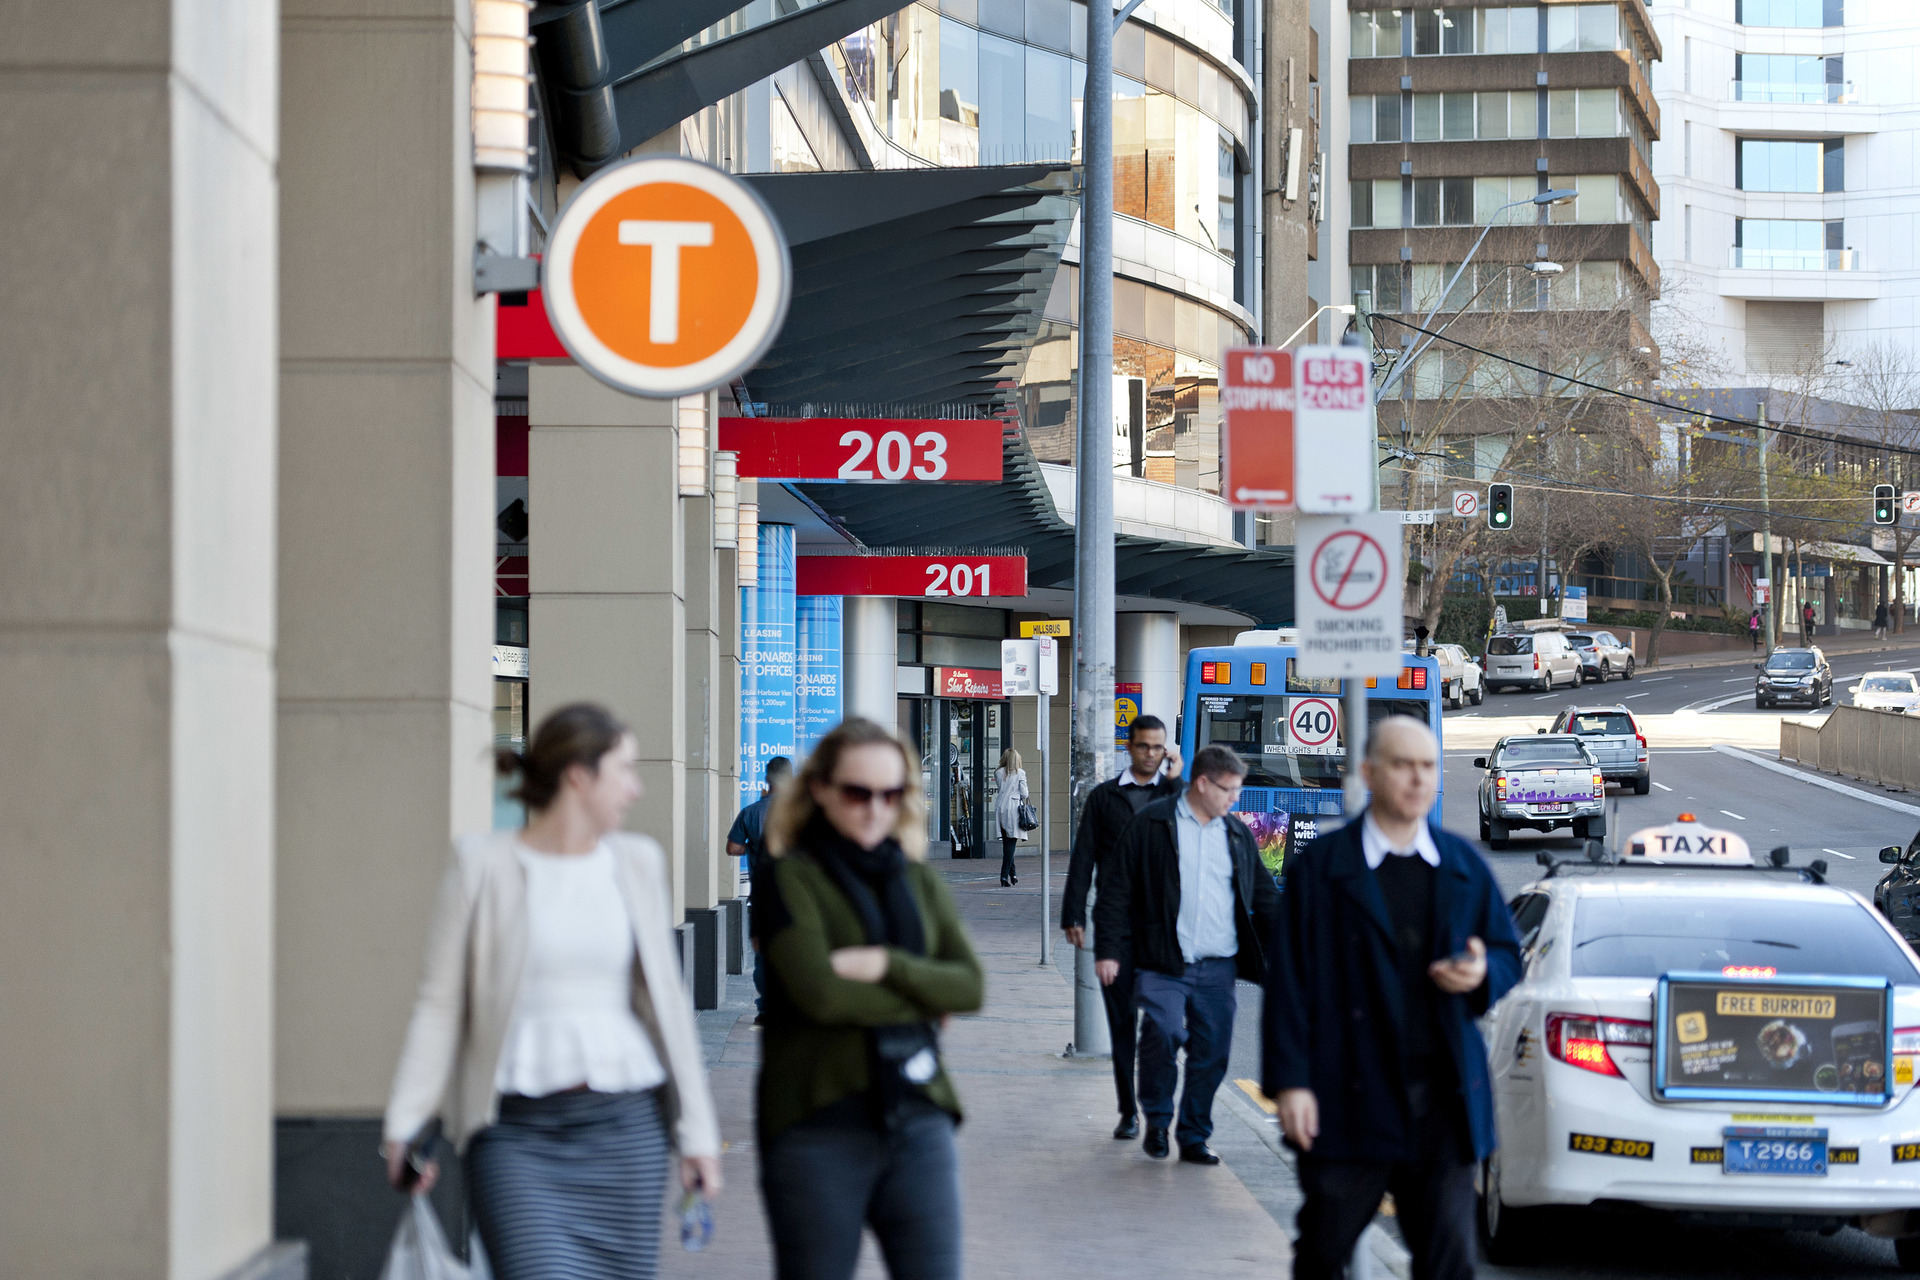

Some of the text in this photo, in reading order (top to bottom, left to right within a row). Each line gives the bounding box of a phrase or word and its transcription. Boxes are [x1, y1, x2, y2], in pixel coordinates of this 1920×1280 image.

[618, 219, 713, 344] T
[1242, 356, 1275, 384] NO
[1308, 361, 1359, 384] BUS
[1223, 387, 1295, 411] STOPPING
[1302, 387, 1365, 408] ZONE
[838, 430, 948, 481] 203
[1418, 513, 1430, 521] ST
[925, 563, 990, 597] 201
[744, 629, 782, 637] LEASING
[1033, 624, 1061, 635] HILLSBUS
[1315, 619, 1383, 634] SMOKING
[1305, 637, 1395, 654] PROHIBITED
[754, 665, 793, 676] OFFICES
[795, 686, 836, 696] OFFICES
[947, 678, 963, 693] Shoe
[964, 678, 989, 697] Repairs
[1118, 713, 1128, 724] A
[1296, 711, 1331, 735] 40
[752, 760, 769, 773] 81
[1294, 831, 1317, 839] with
[1655, 836, 1727, 854] TAXI
[1721, 995, 1832, 1015] FREE BURRITO?
[1573, 1134, 1651, 1157] 133 300
